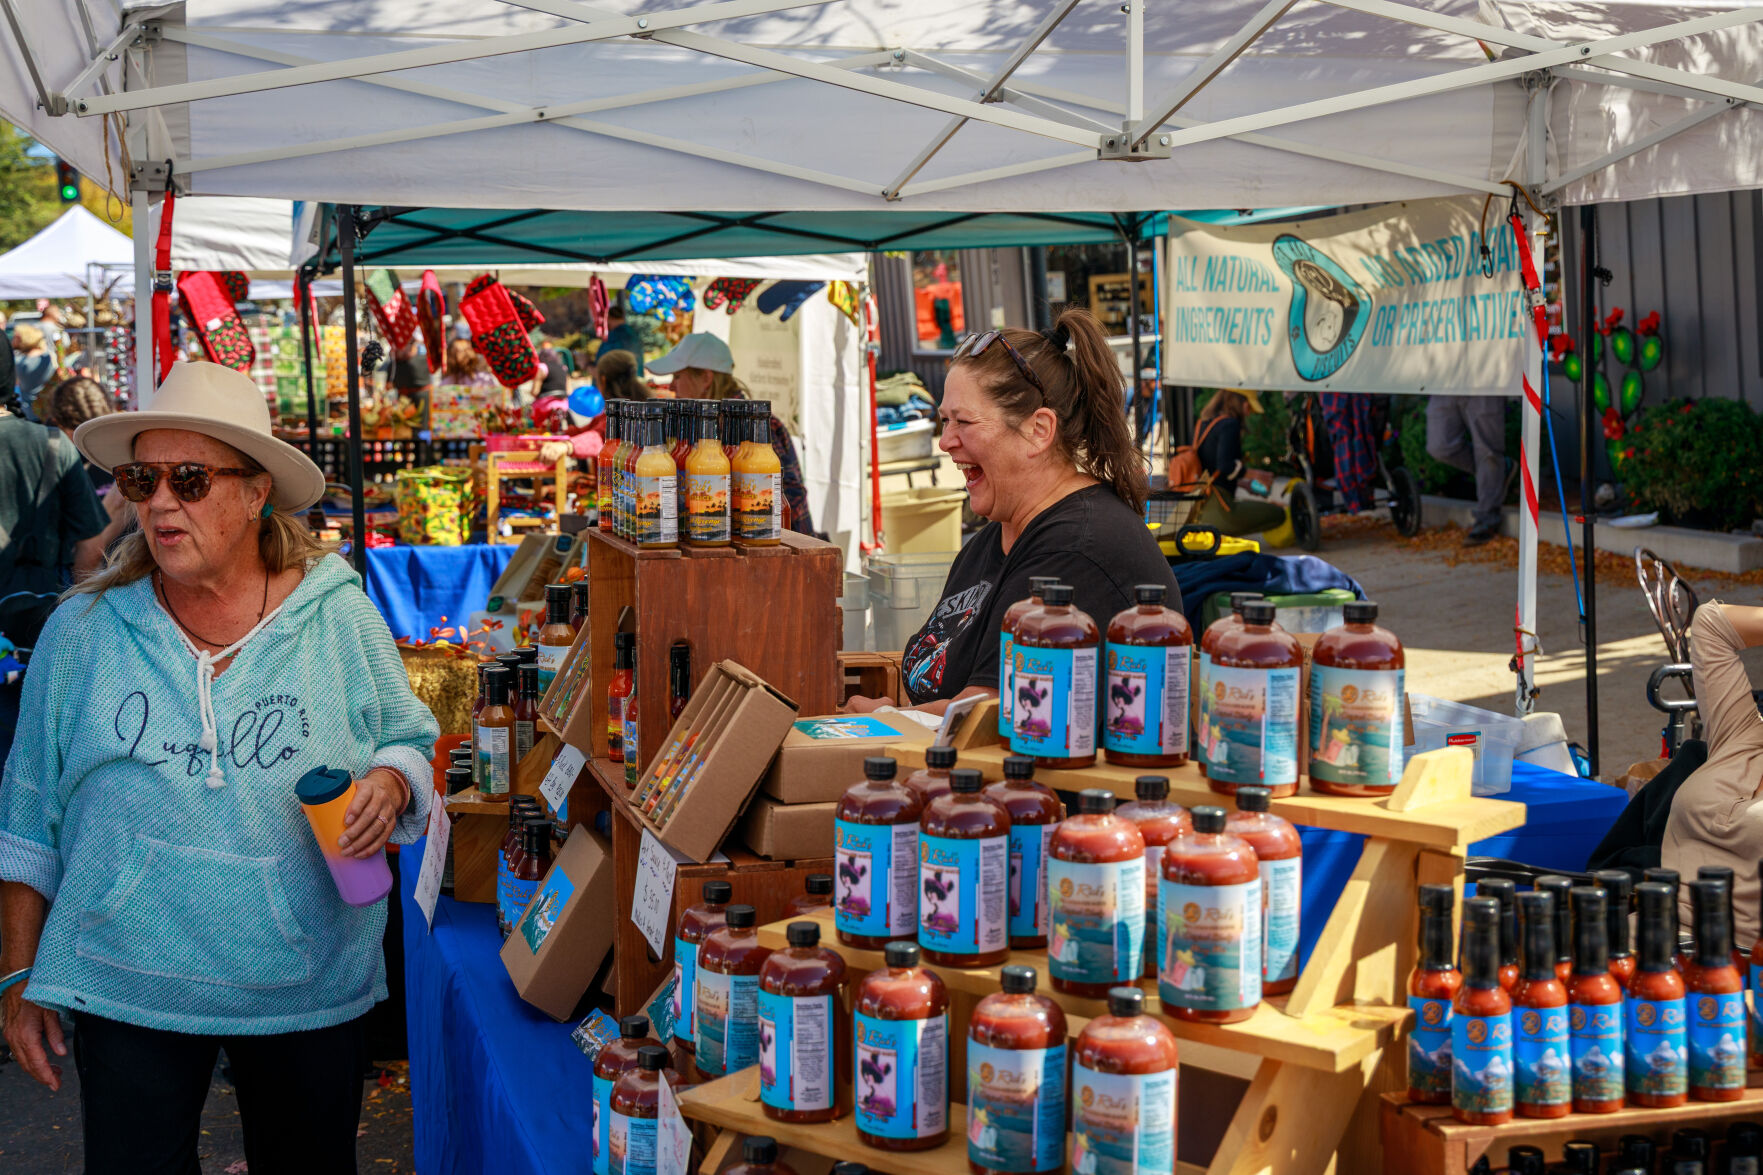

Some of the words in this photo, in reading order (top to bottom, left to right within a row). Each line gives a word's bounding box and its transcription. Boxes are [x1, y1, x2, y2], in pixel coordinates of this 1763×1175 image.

[1176, 255, 1198, 293] ALL
[1202, 254, 1281, 293] NATURAL
[1360, 253, 1401, 290] NO
[1400, 235, 1464, 286] ADDED
[1175, 305, 1275, 347] INGREDIENTS
[1371, 304, 1396, 347] OR
[1398, 290, 1526, 345] PRESERVATIVES
[115, 691, 300, 777] Luqillo
[255, 694, 298, 711] PUERTO
[299, 708, 311, 738] RICO
